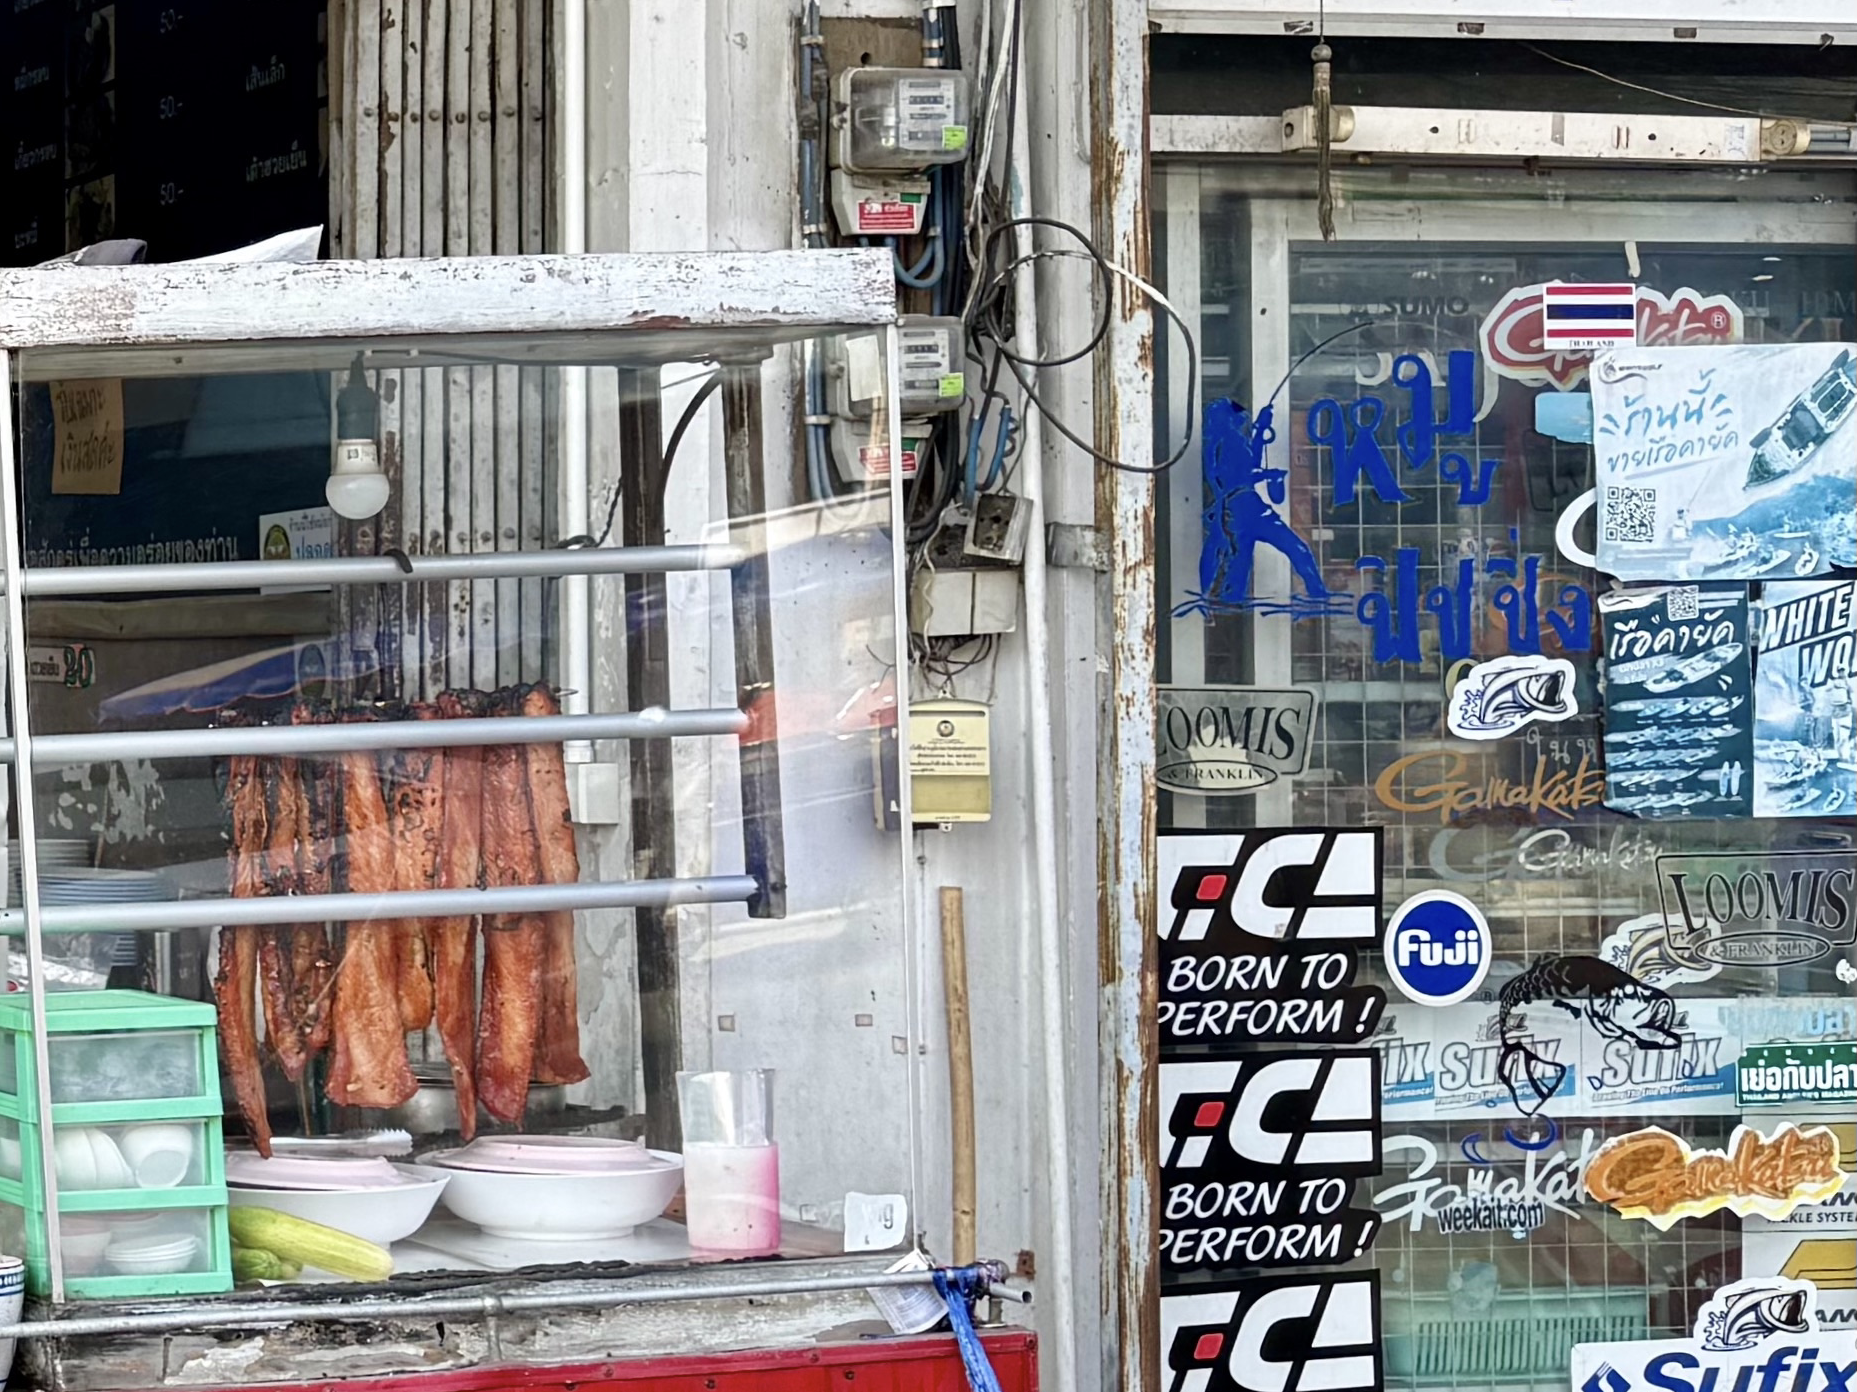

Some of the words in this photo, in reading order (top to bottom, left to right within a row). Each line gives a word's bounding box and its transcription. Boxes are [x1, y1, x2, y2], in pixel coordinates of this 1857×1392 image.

[1760, 583, 1855, 650] WHITE
[1156, 705, 1303, 760] OOMIS
[1184, 767, 1265, 782] FRANKLIN
[1667, 865, 1855, 934] LOOMIS
[1729, 939, 1820, 960] FRANKLIN
[1166, 953, 1292, 993] BORN
[1298, 952, 1349, 990] TO
[1166, 1180, 1290, 1219] BORN
[1297, 1177, 1347, 1214] TO
